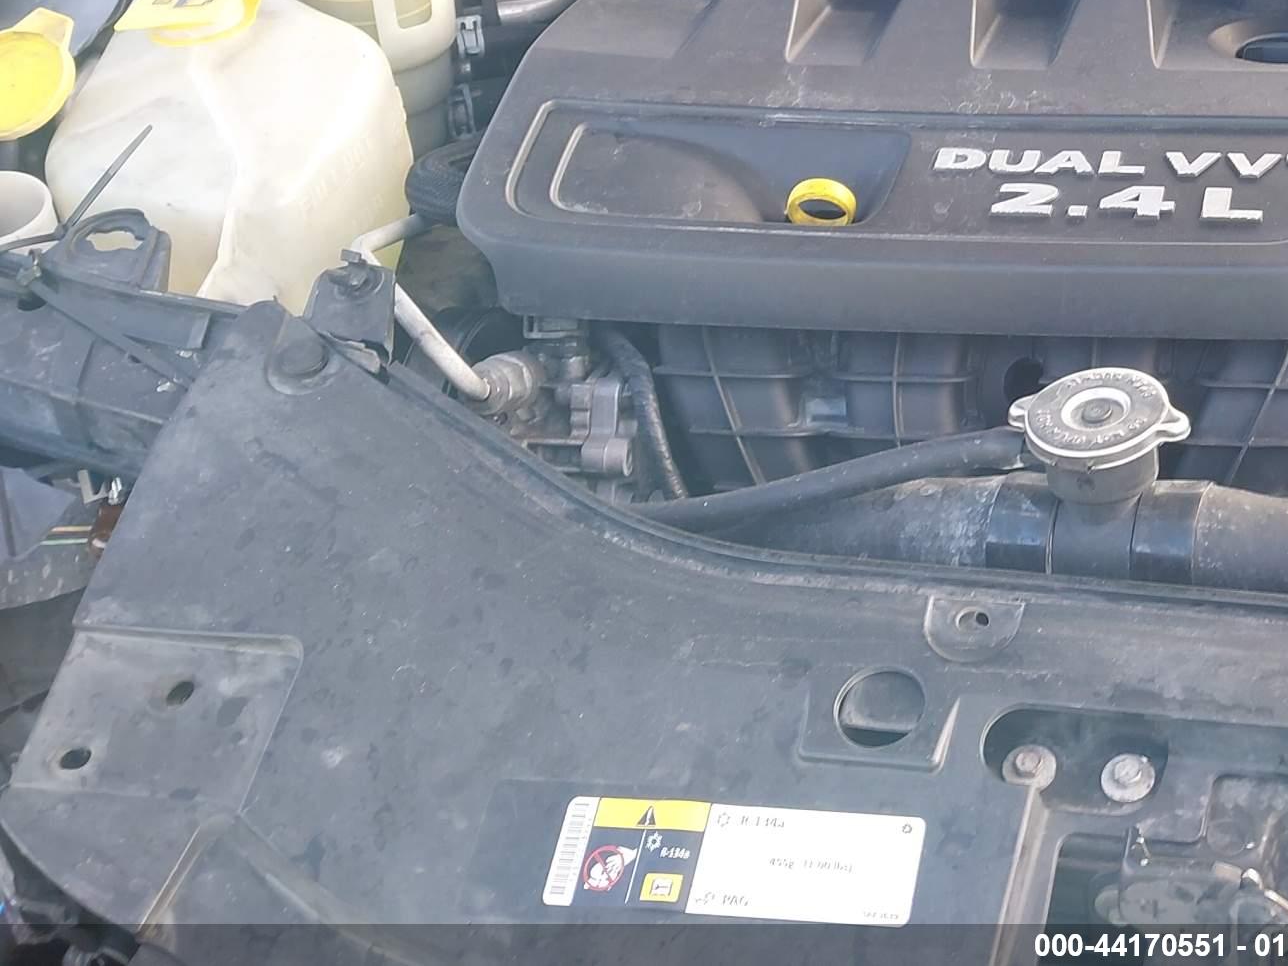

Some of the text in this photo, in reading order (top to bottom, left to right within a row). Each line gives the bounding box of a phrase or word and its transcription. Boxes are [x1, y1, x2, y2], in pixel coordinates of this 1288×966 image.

[933, 147, 1146, 176] DUAL
[988, 182, 1265, 224] 2.4 L
